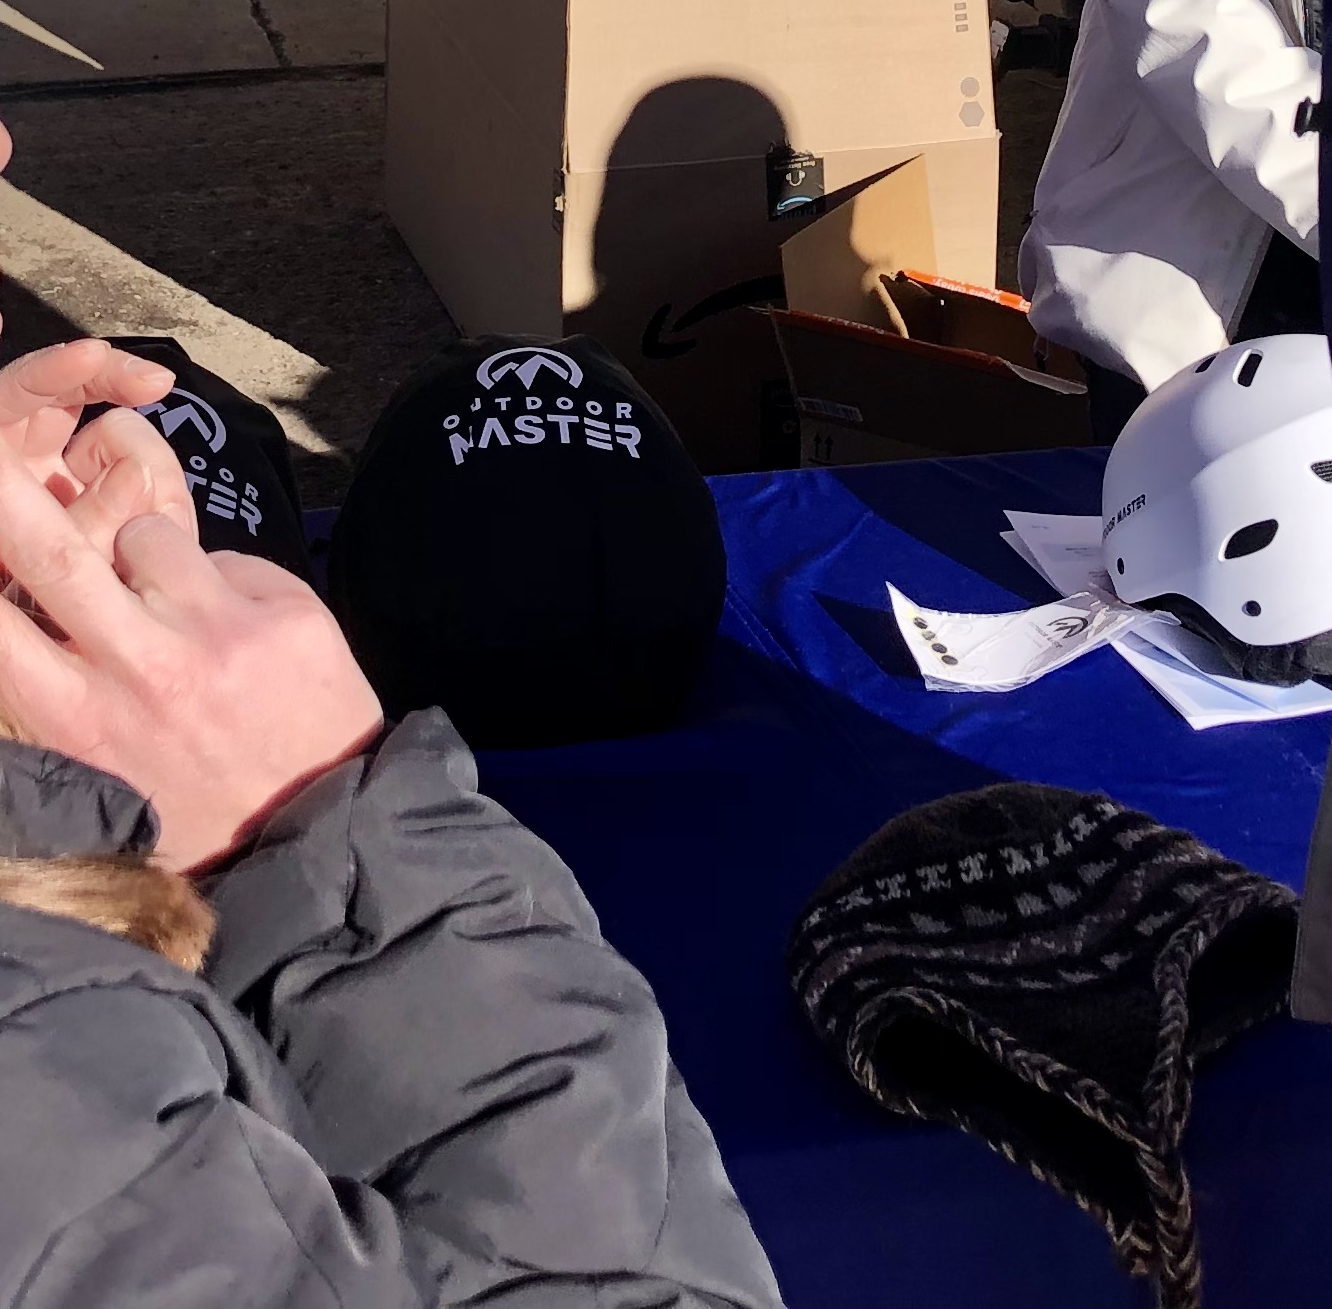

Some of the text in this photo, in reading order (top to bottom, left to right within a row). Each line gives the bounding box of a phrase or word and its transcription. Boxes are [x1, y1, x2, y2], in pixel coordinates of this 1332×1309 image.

[442, 396, 633, 430] OUTDOOR
[448, 413, 642, 466] MASTER
[1117, 494, 1146, 523] MASTER
